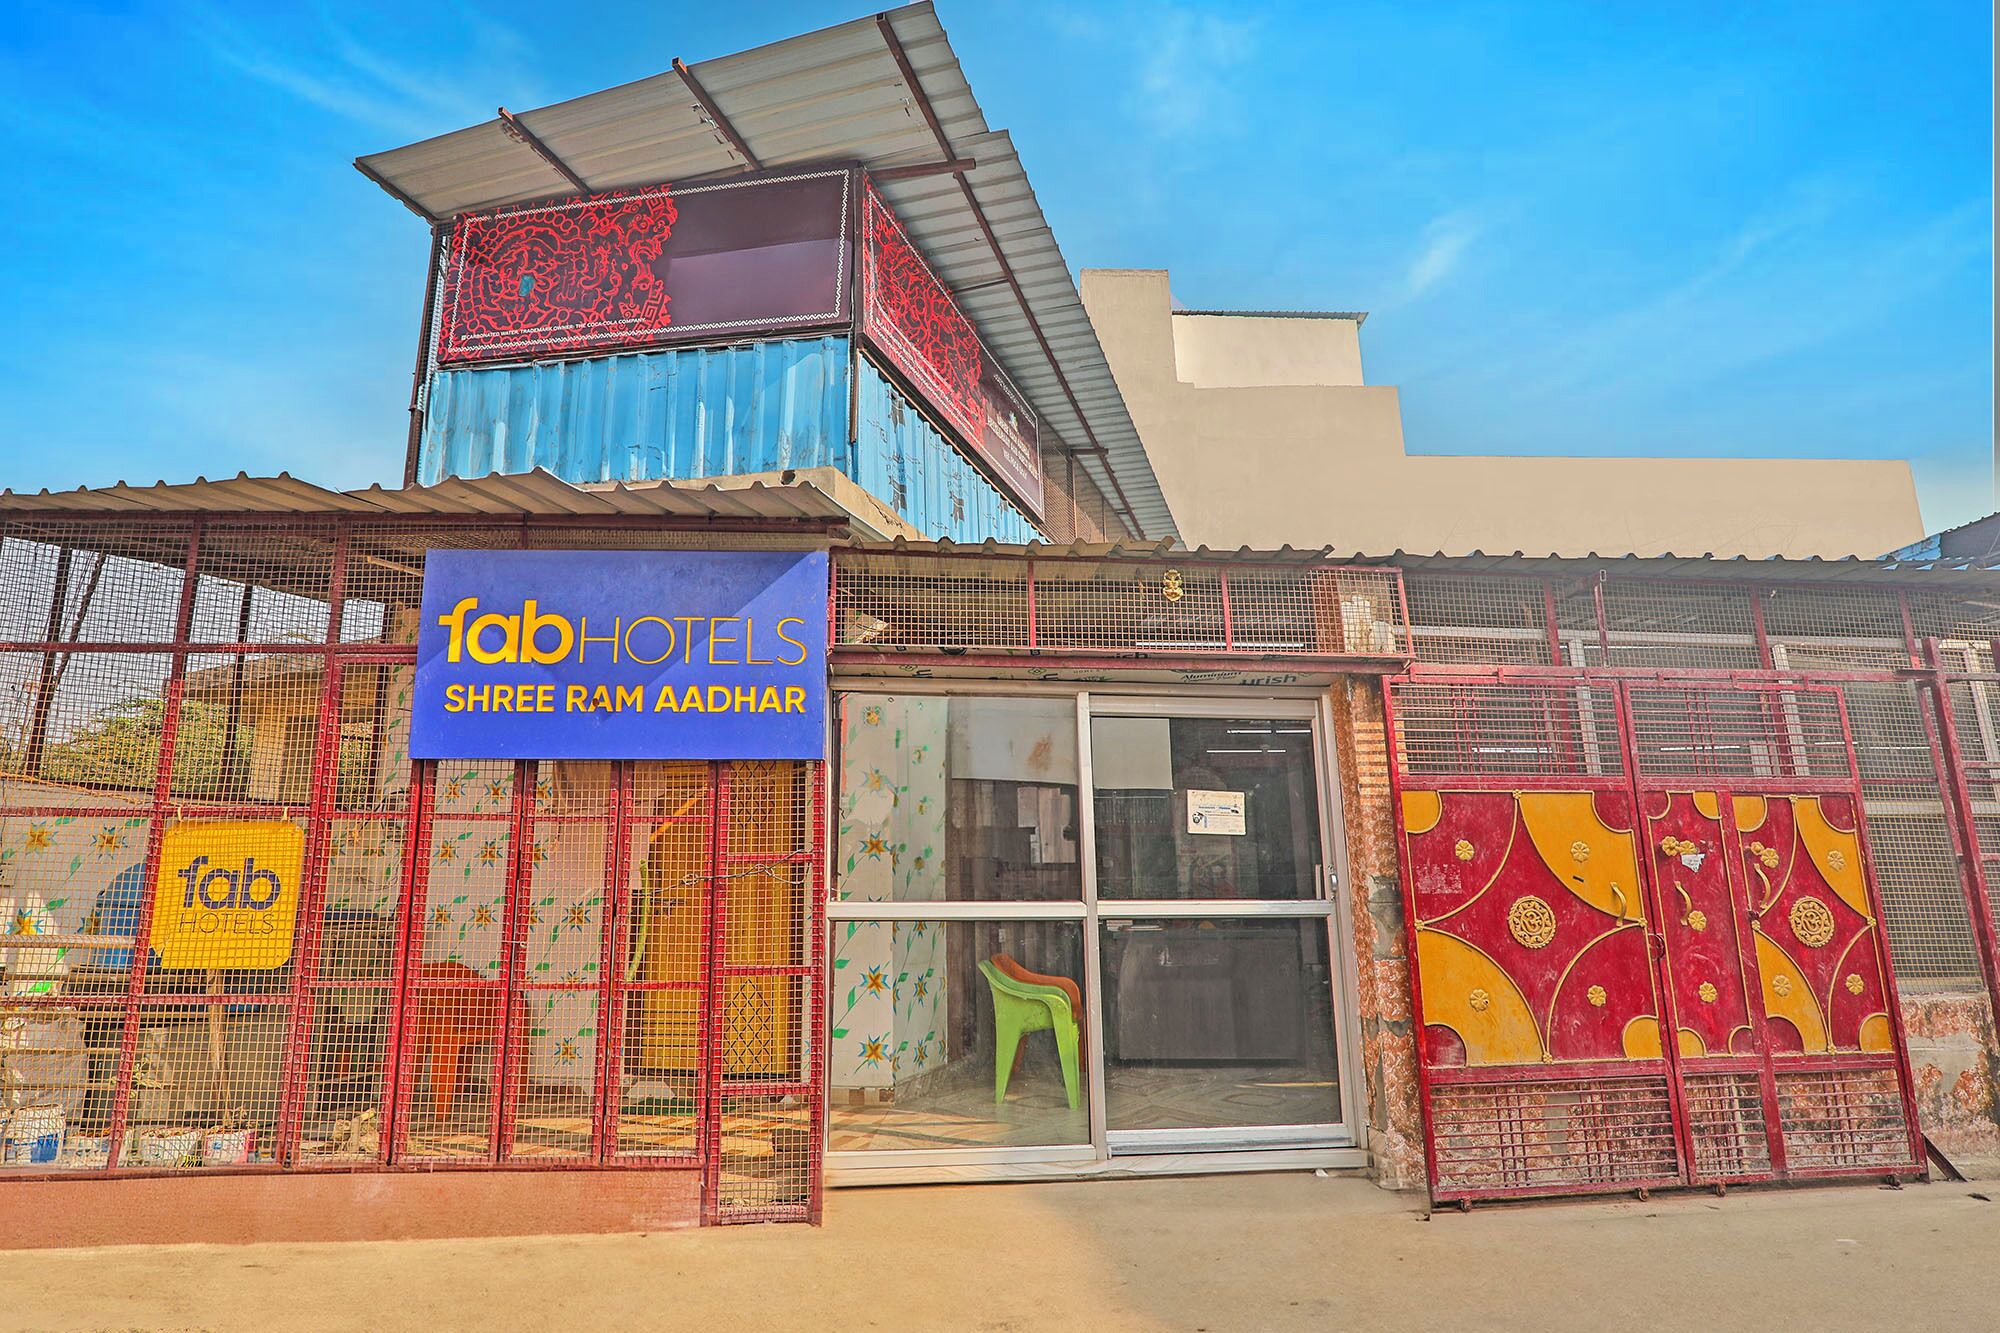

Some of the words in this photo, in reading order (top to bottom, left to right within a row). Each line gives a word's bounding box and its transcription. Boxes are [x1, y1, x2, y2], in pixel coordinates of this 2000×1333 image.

[520, 326, 553, 334] TRADEMARK
[587, 320, 618, 328] COCA-COLA
[444, 684, 555, 713] SHREE
[566, 685, 644, 713] RAM
[653, 685, 807, 714] AADHAR
[178, 855, 281, 910] fab
[178, 912, 275, 935] HOTELS
